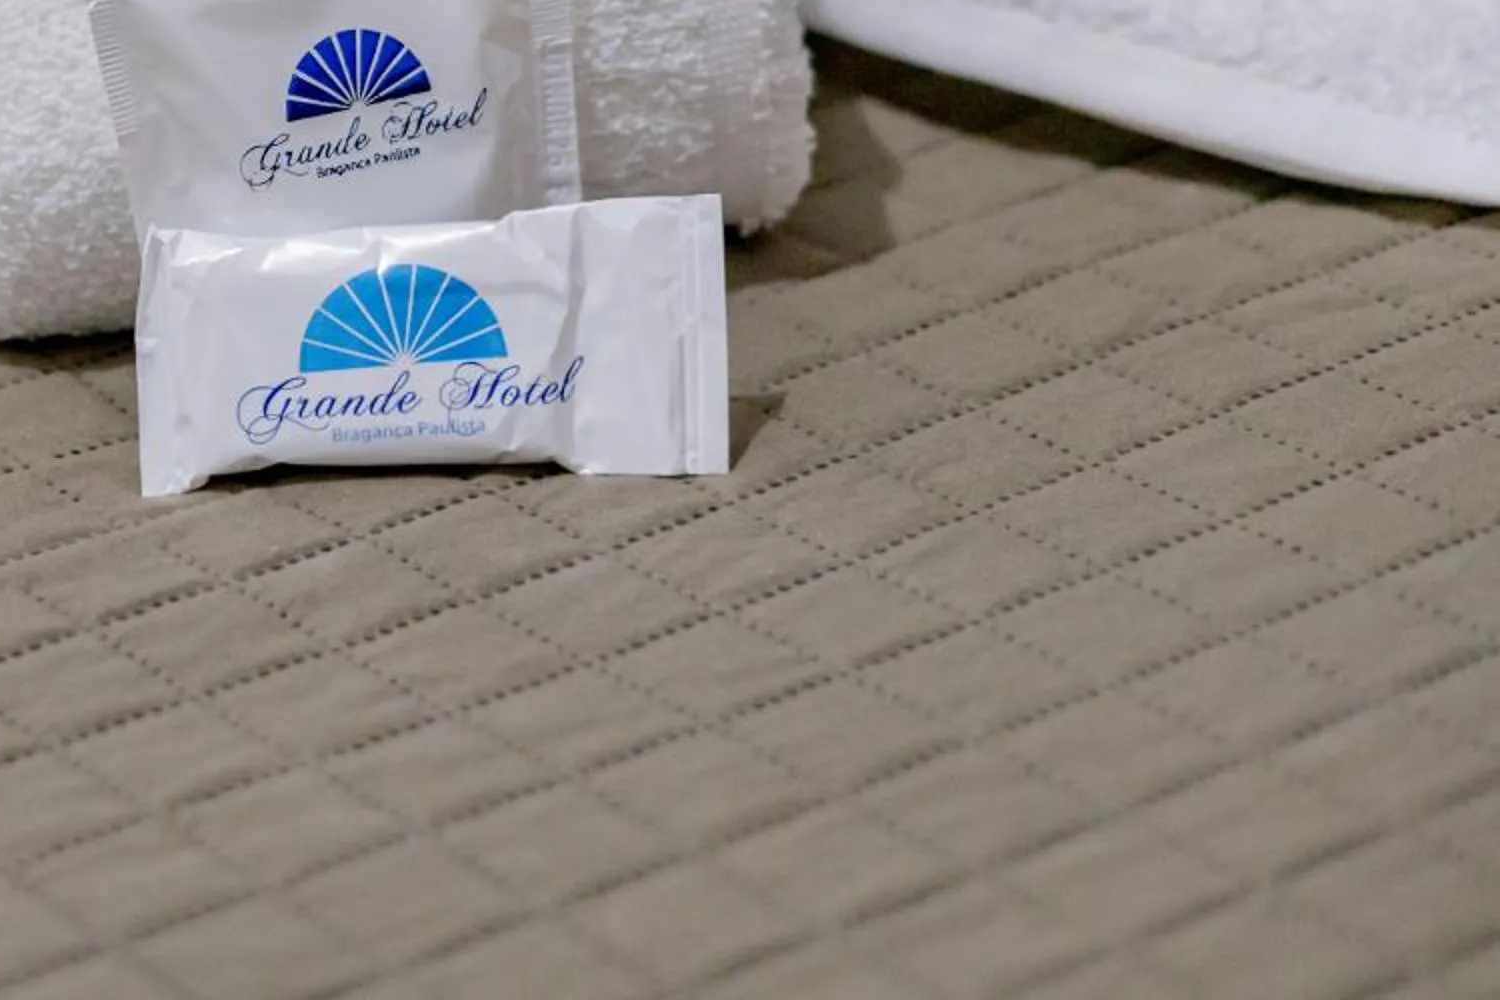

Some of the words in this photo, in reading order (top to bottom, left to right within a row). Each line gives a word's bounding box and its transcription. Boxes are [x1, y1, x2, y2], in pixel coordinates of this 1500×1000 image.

[240, 116, 371, 189] Grande
[382, 88, 488, 143] Hotel
[237, 371, 423, 444] Grande
[439, 356, 585, 416] Hotel
[417, 417, 486, 436] Paulista
